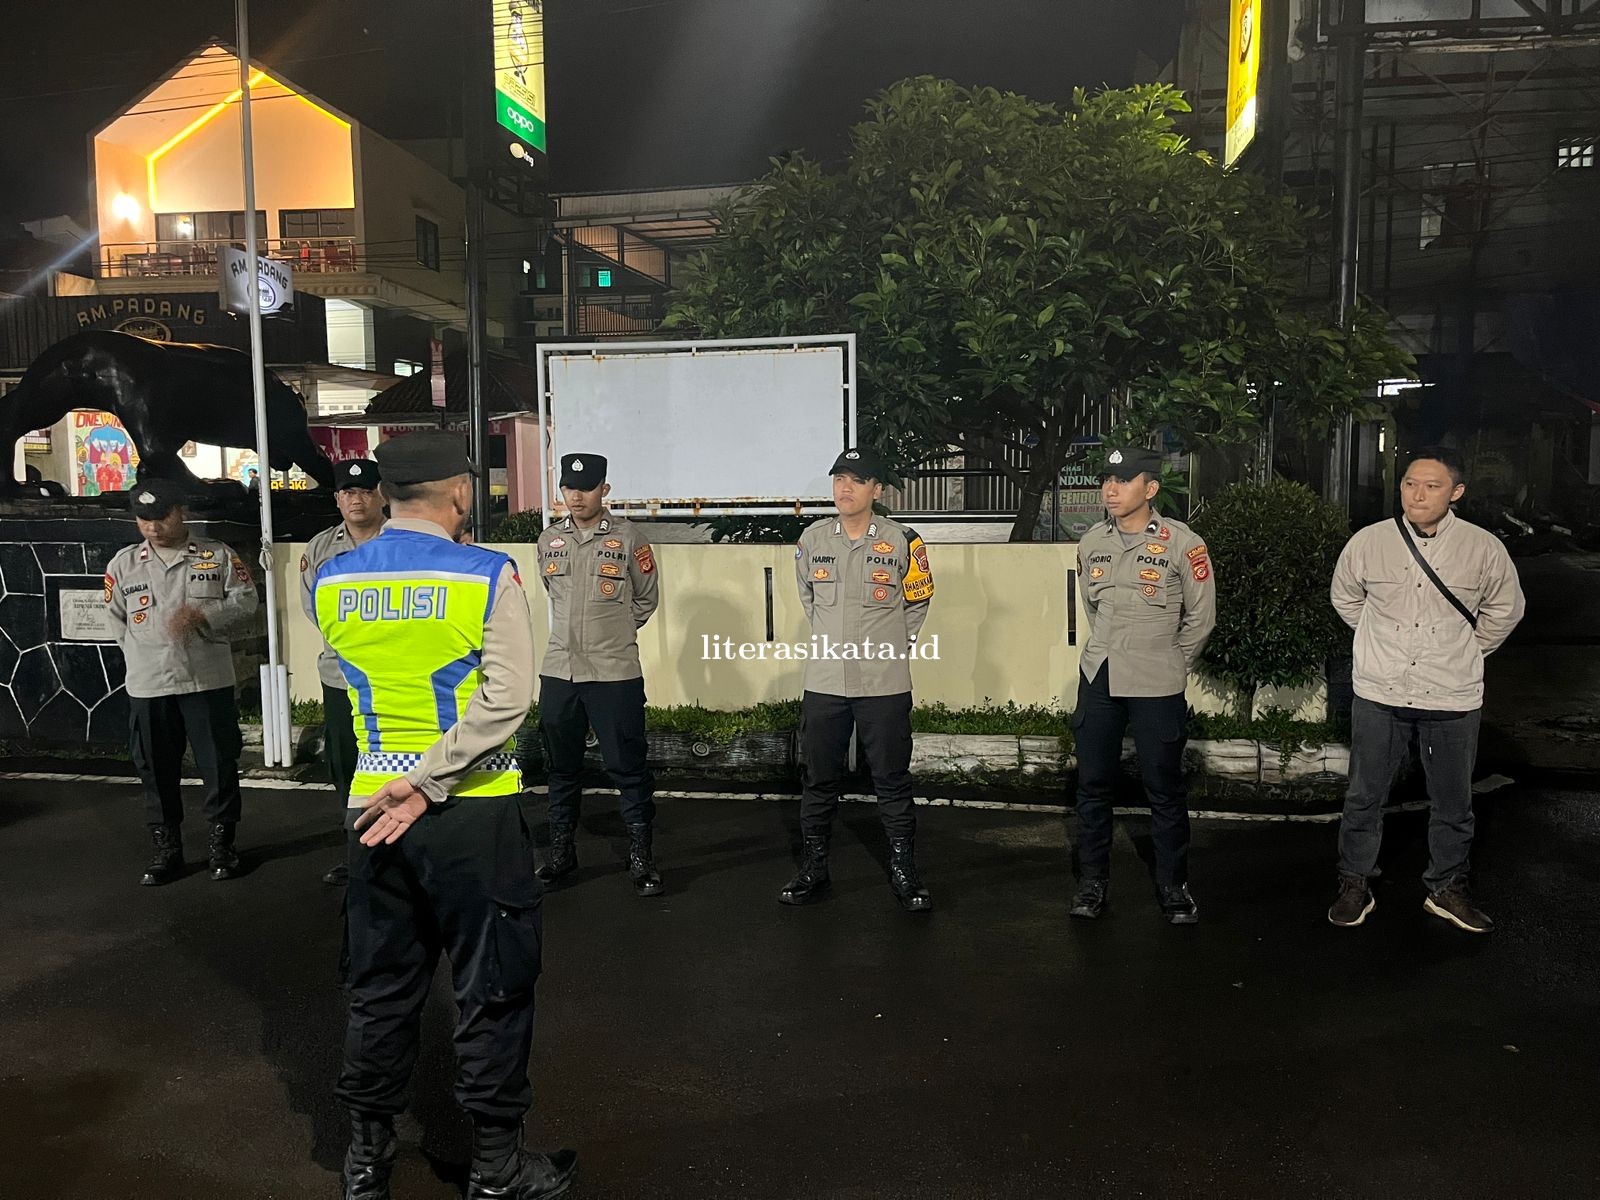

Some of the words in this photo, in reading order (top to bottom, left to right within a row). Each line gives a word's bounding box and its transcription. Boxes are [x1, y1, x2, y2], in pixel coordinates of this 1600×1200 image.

[507, 106, 534, 132] oppo
[257, 260, 288, 290] ADANG
[1060, 475, 1100, 486] NDUNG
[544, 551, 568, 559] FADLI
[597, 550, 627, 561] POLRI
[866, 556, 897, 566] POLRI
[1136, 555, 1169, 568] POLRI
[190, 573, 221, 582] POLRI
[338, 586, 448, 622] POLISI
